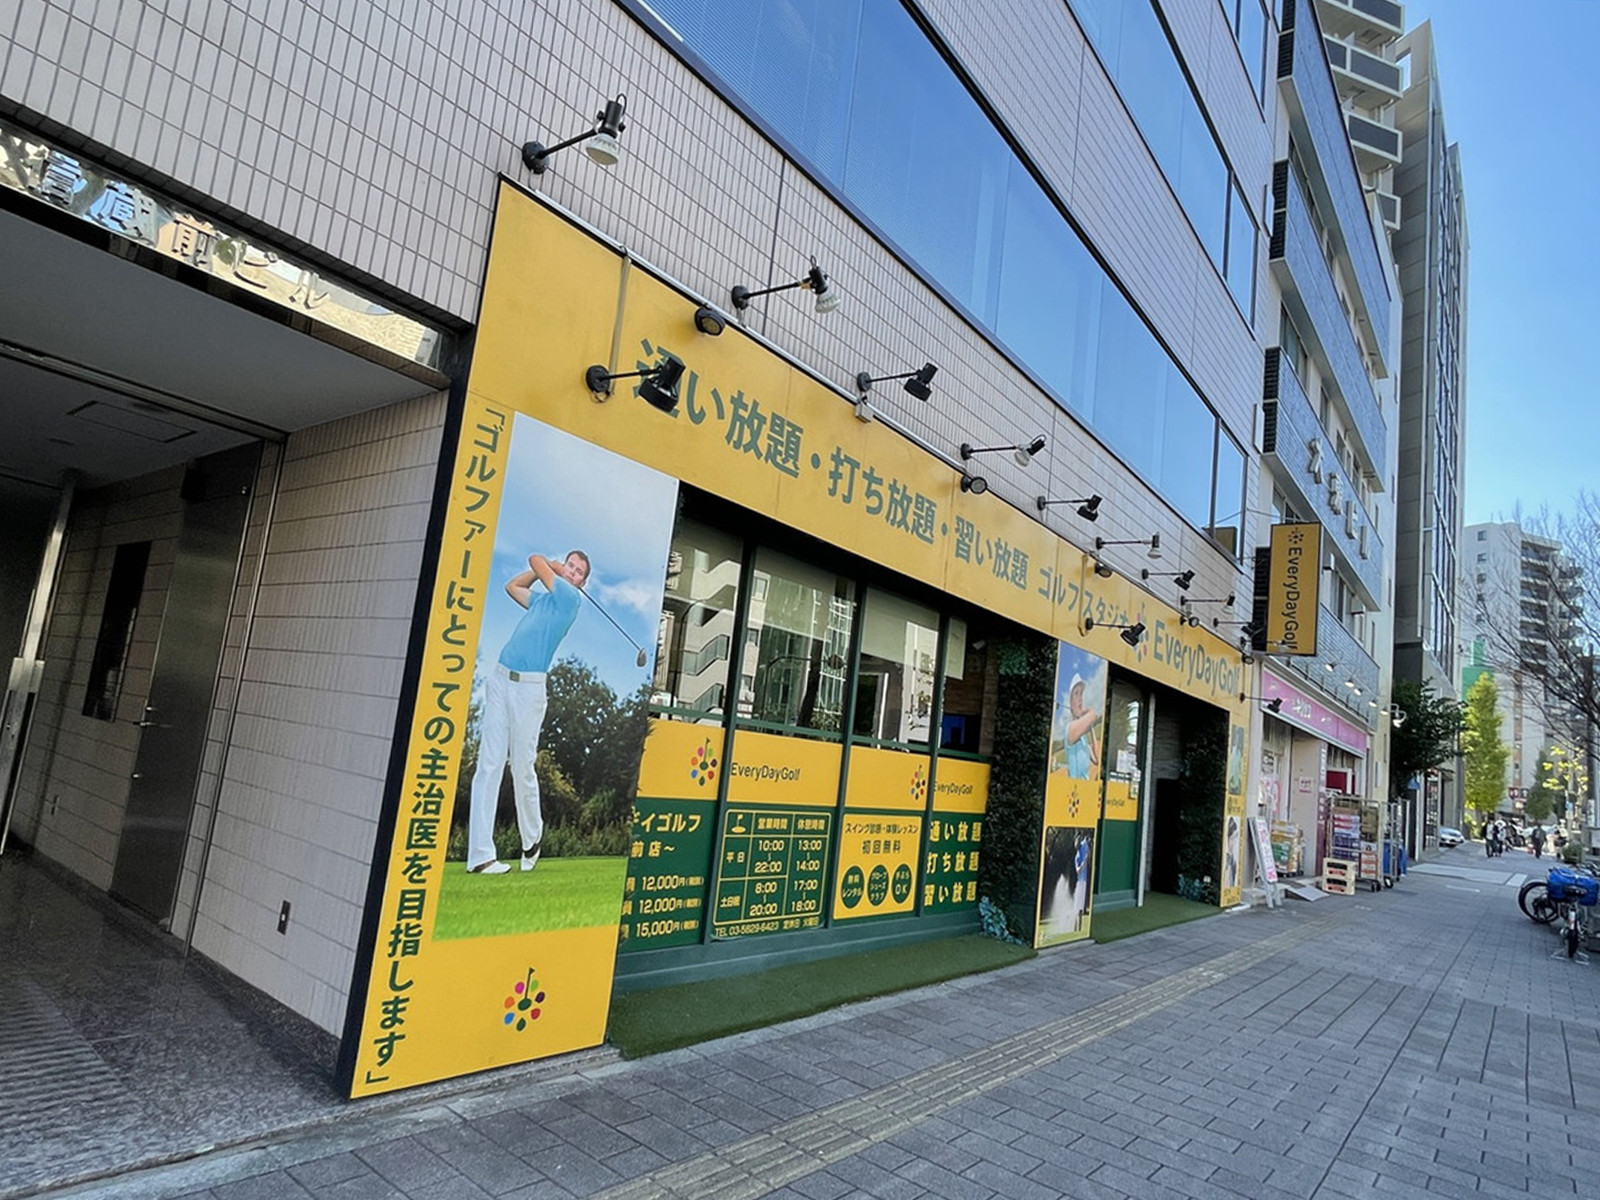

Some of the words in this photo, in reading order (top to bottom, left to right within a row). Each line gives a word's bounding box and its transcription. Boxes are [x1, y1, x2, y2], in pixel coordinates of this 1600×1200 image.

[1281, 546, 1303, 651] EveryDayGolf
[1154, 619, 1241, 698] EveryDayGolf
[365, 407, 506, 1084] 「ゴルファーにとっての主治医を目指します」
[730, 762, 801, 782] EveryDayGolf
[929, 820, 982, 842] 通い放題
[758, 840, 784, 851] 10:00
[798, 840, 822, 851] 13:00
[862, 840, 901, 855] 初回無料
[726, 851, 746, 864] 平日
[926, 851, 980, 875] 打ち放題
[754, 861, 782, 873] 22:00
[796, 860, 820, 871] 14:00
[754, 882, 778, 894] 8:00
[794, 880, 818, 891] 17:00
[923, 881, 978, 907] 習い放題
[749, 903, 777, 917] 20:00
[791, 899, 816, 912] 18:00
